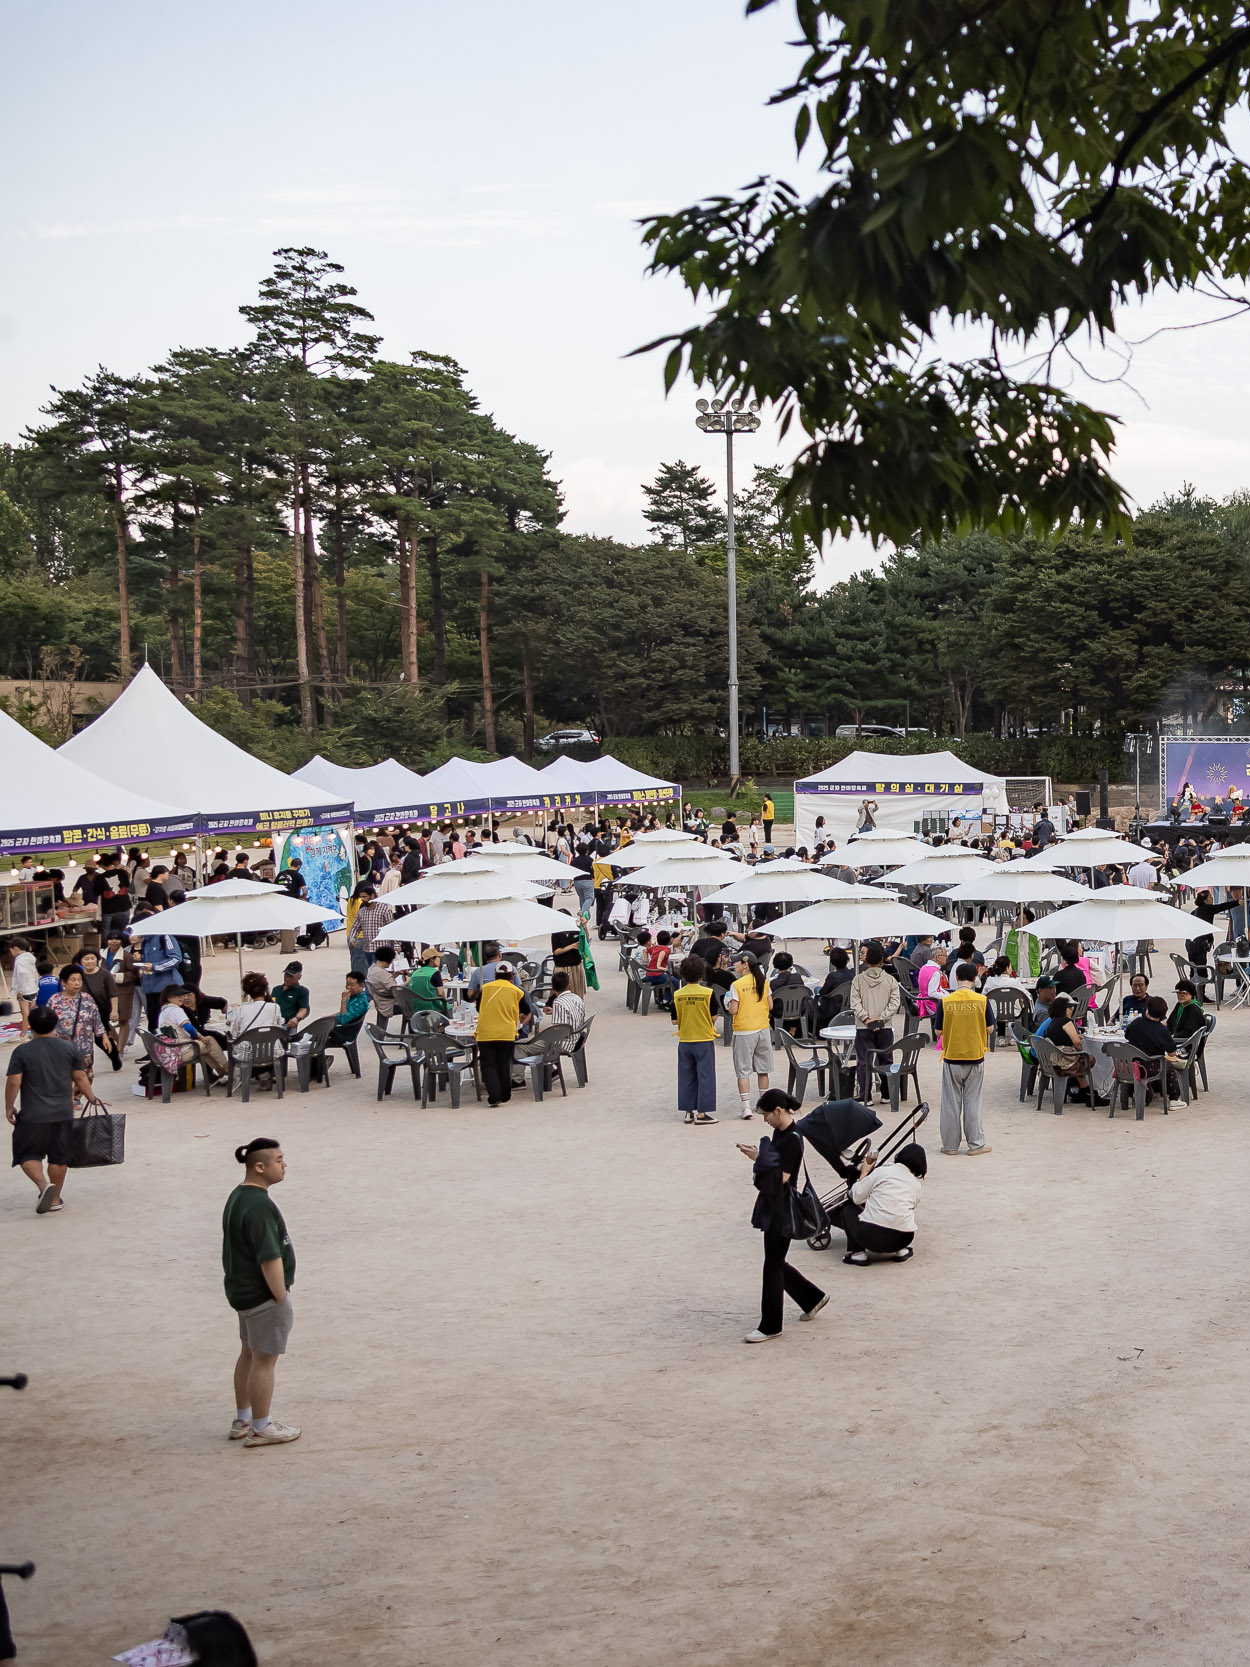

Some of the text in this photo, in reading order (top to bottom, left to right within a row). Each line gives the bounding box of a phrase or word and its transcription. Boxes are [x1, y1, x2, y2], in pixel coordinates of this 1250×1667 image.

[15, 837, 29, 847] 군자
[30, 834, 61, 846] 한마당축제
[946, 1002, 977, 1012] GUESS
